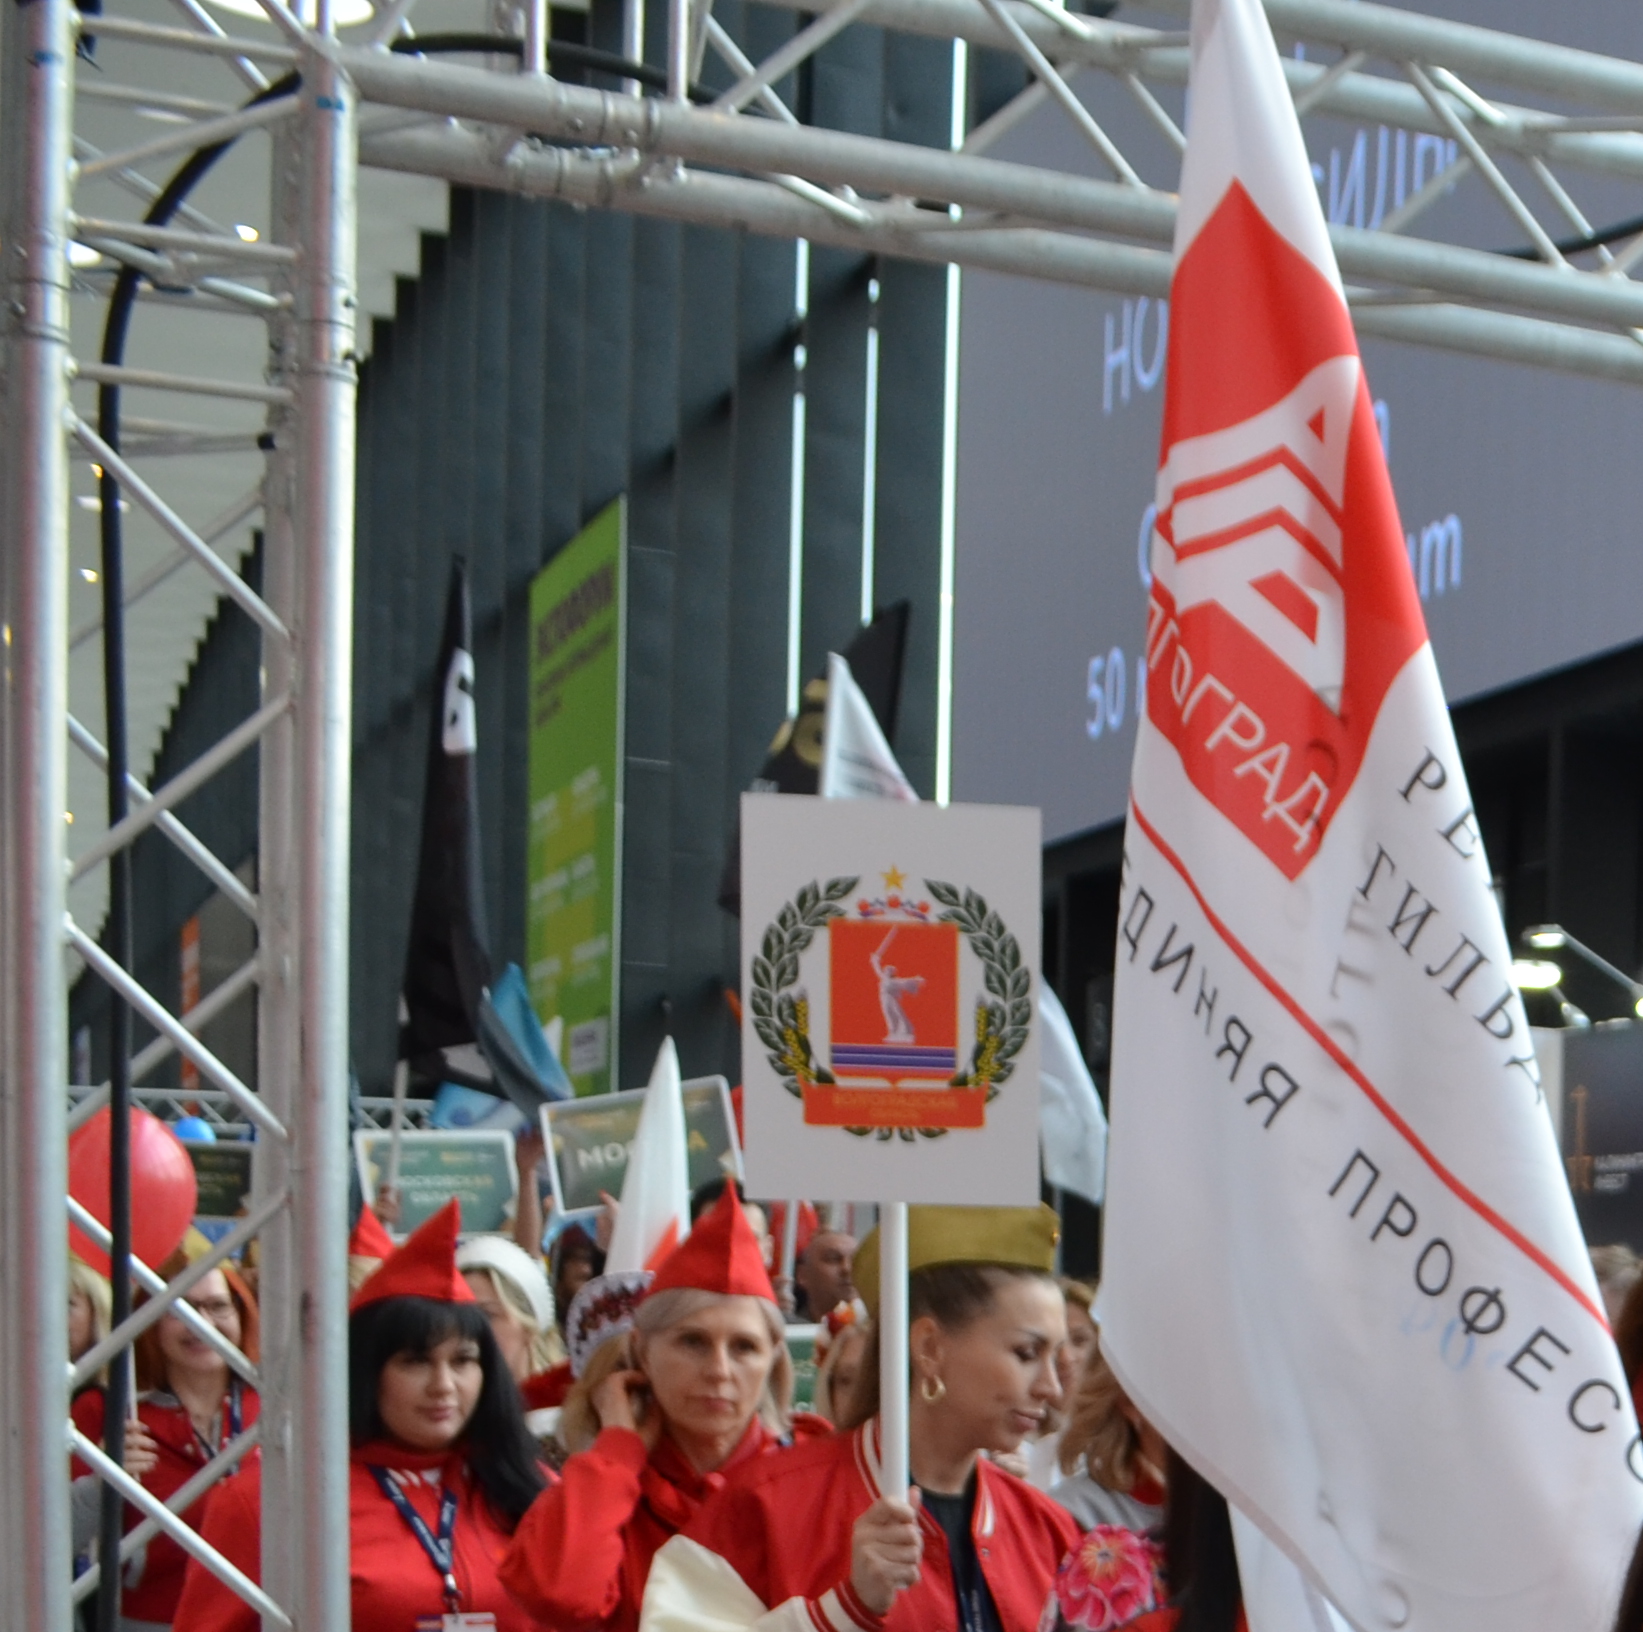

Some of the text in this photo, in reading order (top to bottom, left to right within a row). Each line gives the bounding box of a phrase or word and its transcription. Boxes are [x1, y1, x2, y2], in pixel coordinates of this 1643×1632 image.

[1397, 745, 1496, 892] РЕ
[1119, 845, 1301, 1130] ДИНЯЯ
[576, 1128, 708, 1171] МОА
